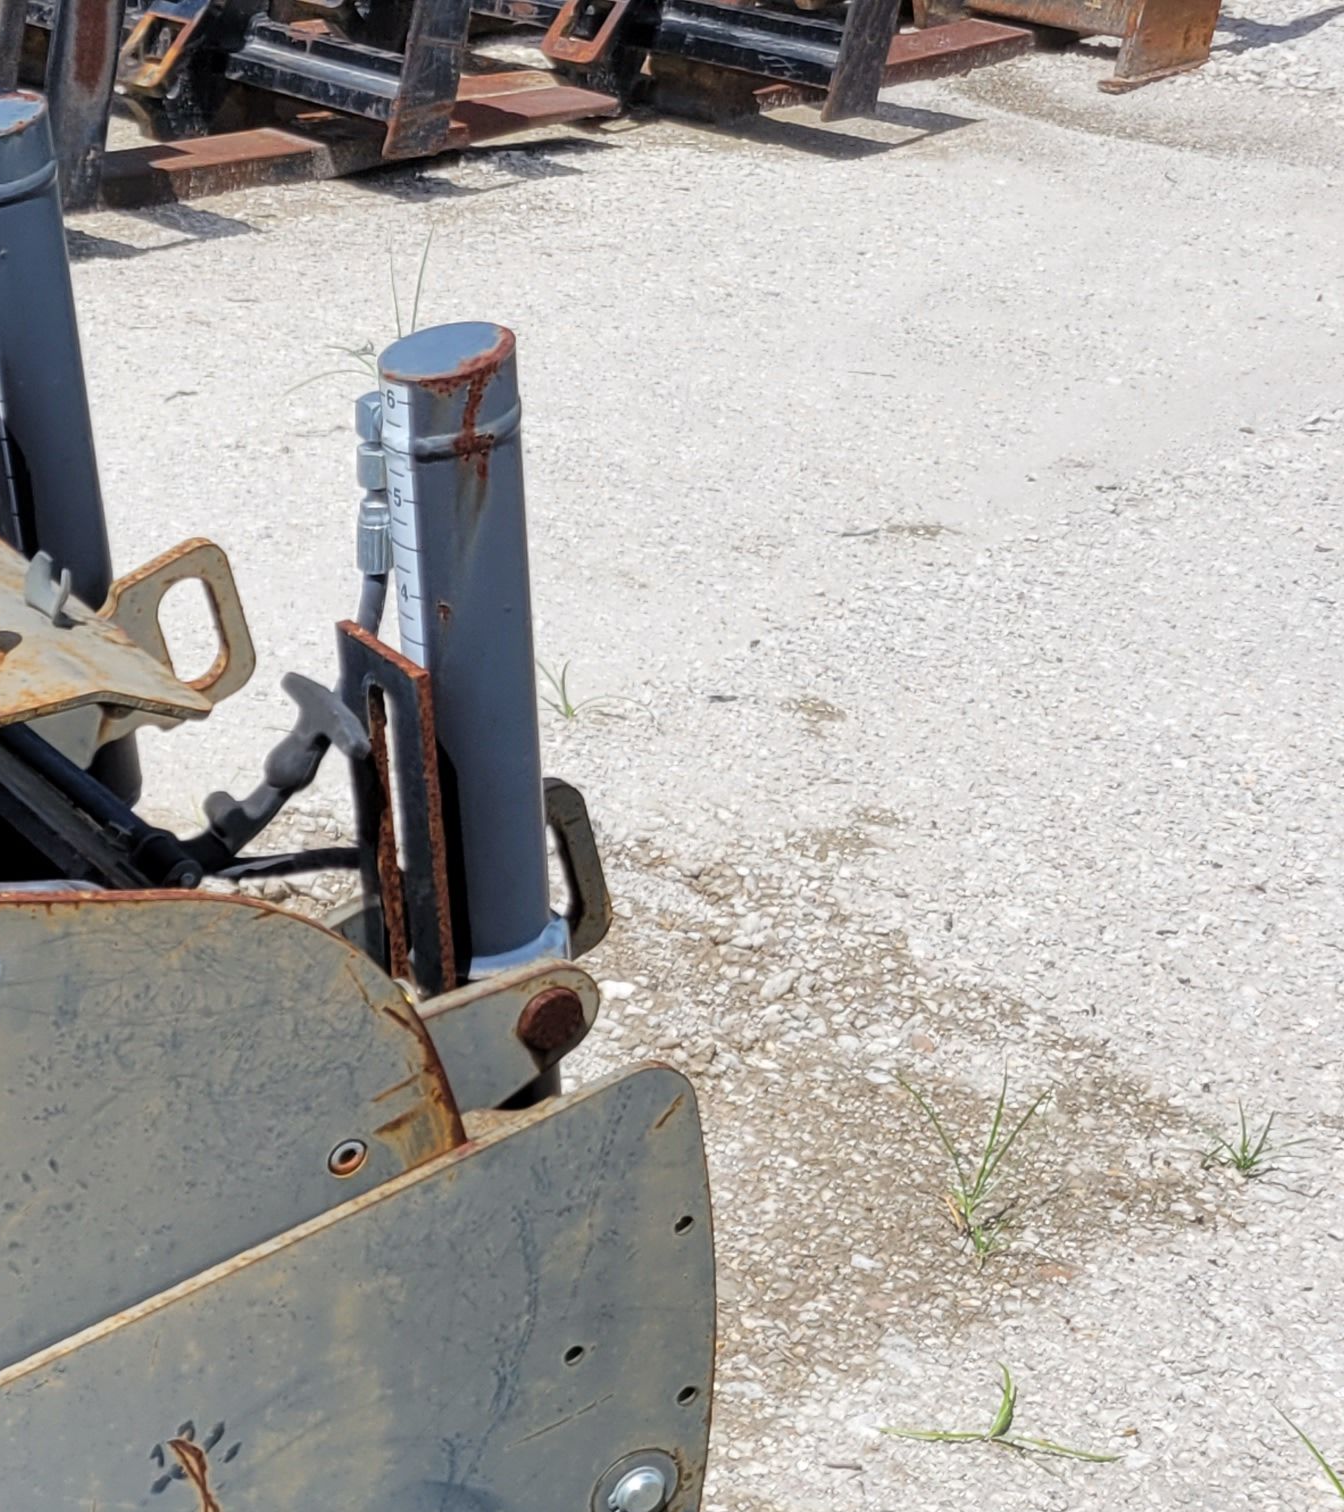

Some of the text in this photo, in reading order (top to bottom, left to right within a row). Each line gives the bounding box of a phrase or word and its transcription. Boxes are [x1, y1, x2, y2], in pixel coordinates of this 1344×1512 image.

[385, 389, 396, 409] 6
[392, 488, 402, 508] 5
[400, 584, 409, 603] 4
